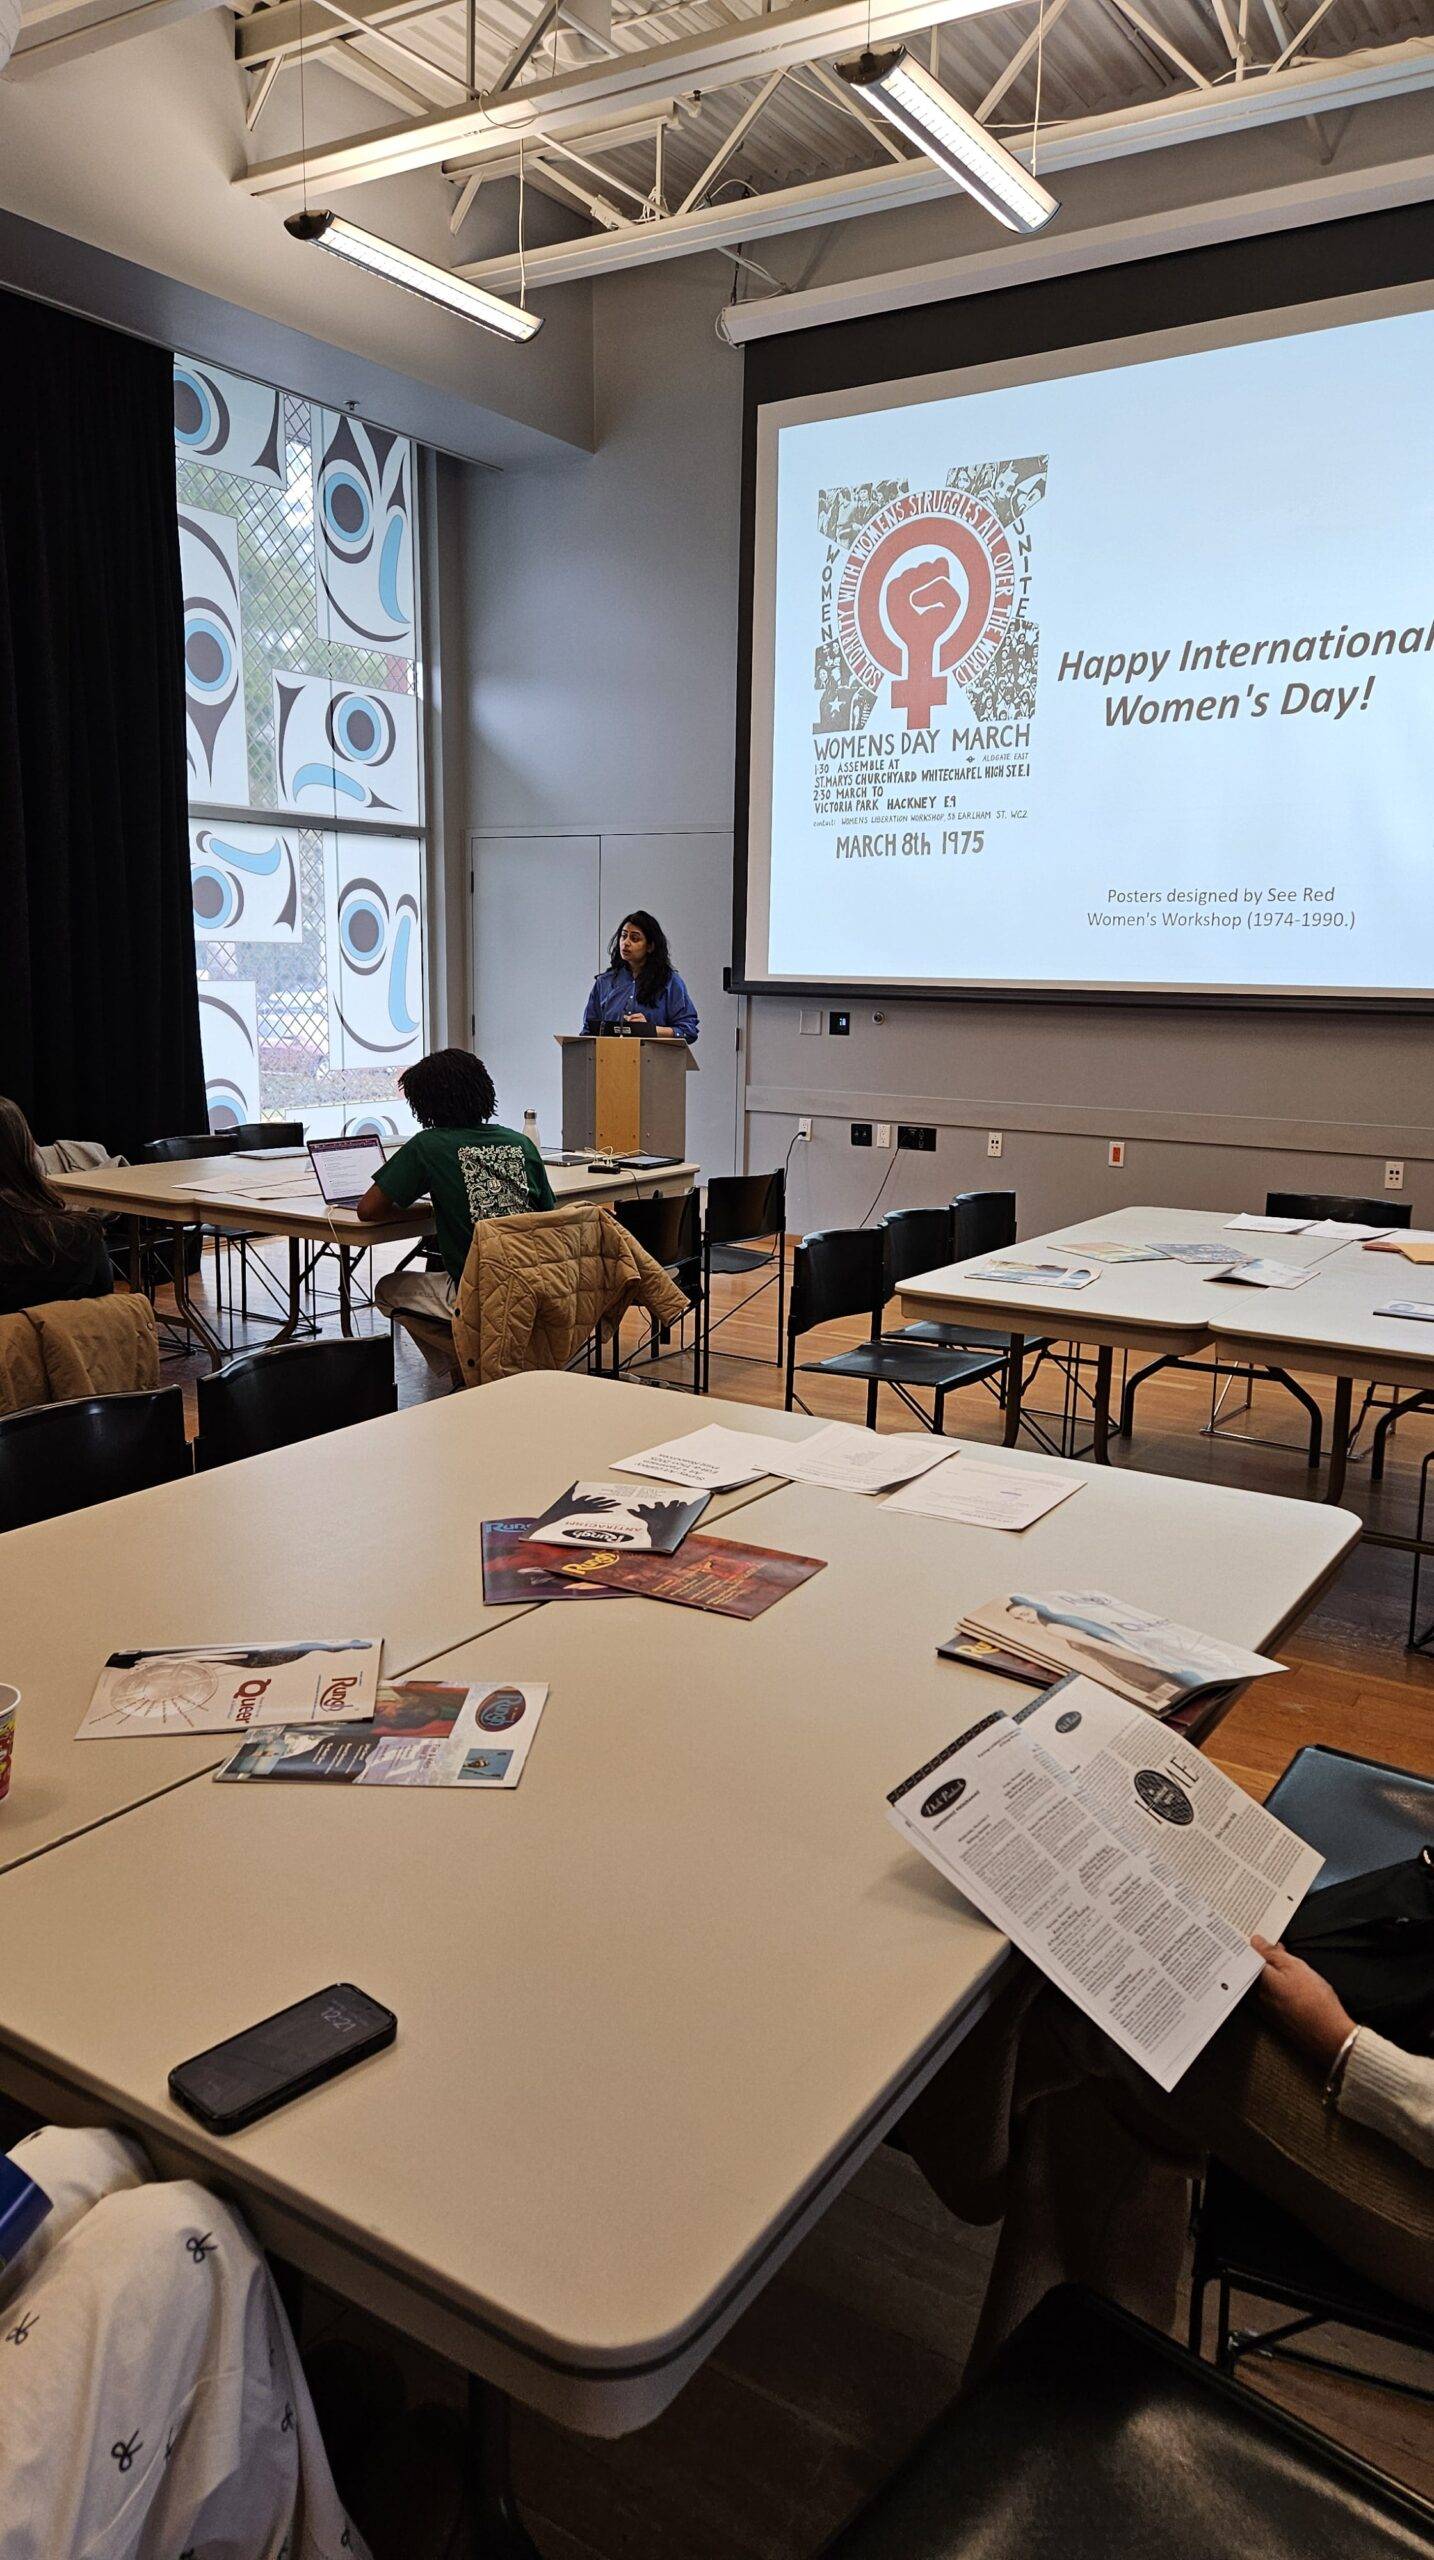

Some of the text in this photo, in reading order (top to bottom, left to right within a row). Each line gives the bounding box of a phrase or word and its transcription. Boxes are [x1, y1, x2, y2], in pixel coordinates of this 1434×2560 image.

[821, 544, 840, 642] WOMEN
[838, 490, 1015, 690] SOLIDARITY WITH WOMENS STRUGGLES ALL OVER THE WORLD
[1057, 619, 1434, 686] Happy International
[1104, 675, 1376, 727] Women's Day!
[814, 723, 1030, 761] WOMENS DAY MARCH
[838, 759, 884, 773] ASSEMBLE
[888, 759, 900, 769] AT
[855, 771, 917, 786] CHURCHYARD
[921, 766, 982, 781] WHITECHAPEL
[985, 764, 1004, 778] HIGH
[815, 800, 851, 814] VICTORIA
[856, 799, 879, 811] PARK
[887, 796, 936, 810] HACKNEY
[836, 787, 867, 799] MARCH
[872, 786, 884, 797] TO
[841, 815, 868, 825] WOMENS
[871, 813, 908, 824] LIBERATION
[957, 811, 991, 820] EARLHAM
[1010, 810, 1028, 819] WC2
[836, 830, 985, 859] MARCH 8th 1975
[1107, 887, 1335, 906] Posters designed by See Red
[1088, 911, 1356, 930] Women's Workshop (1974-1990.)
[572, 1529, 624, 1543] Rungh
[234, 1679, 272, 1724] Queer
[320, 1676, 356, 1712] Rungh
